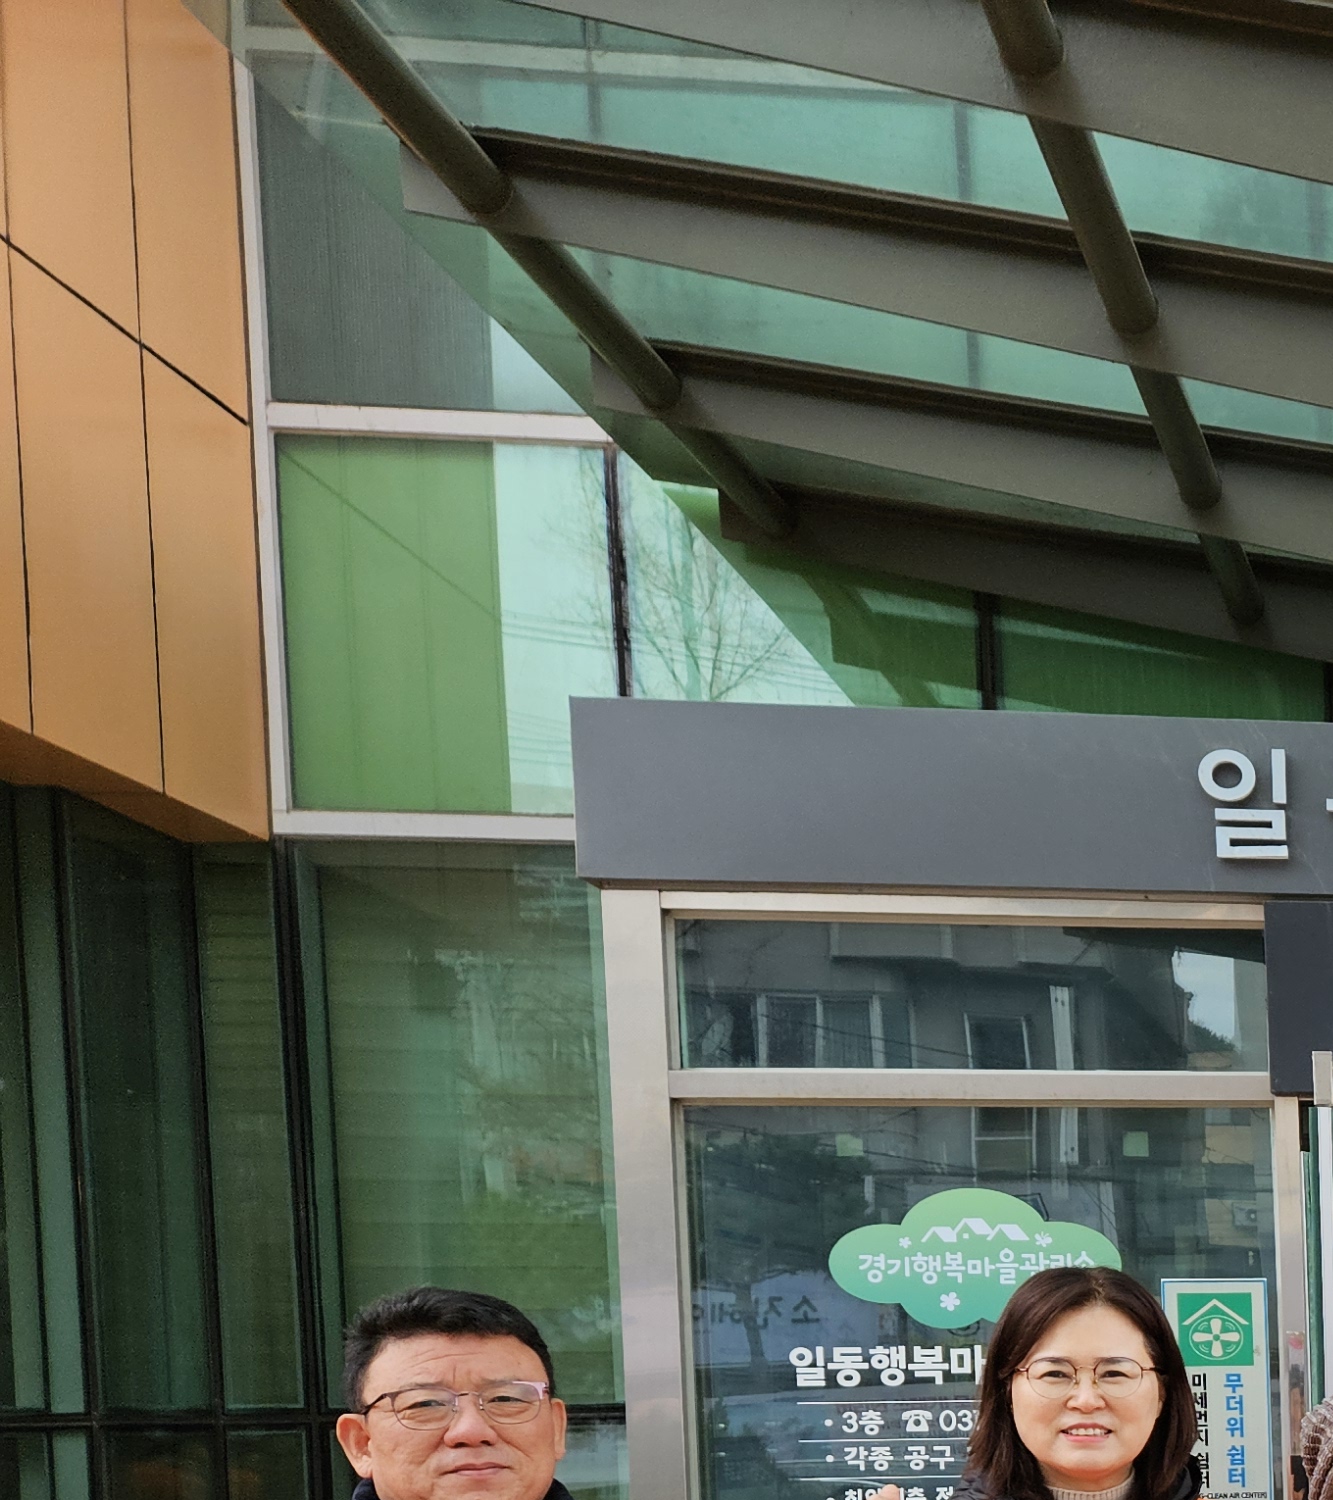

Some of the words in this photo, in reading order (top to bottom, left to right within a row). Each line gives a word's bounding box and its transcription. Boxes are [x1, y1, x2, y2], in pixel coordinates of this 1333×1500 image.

[1224, 1373, 1244, 1438] 무더위
[842, 1410, 884, 1436] 3층
[844, 1446, 894, 1471] 각종
[904, 1446, 954, 1470] 공구
[1226, 1445, 1245, 1488] 쉼터
